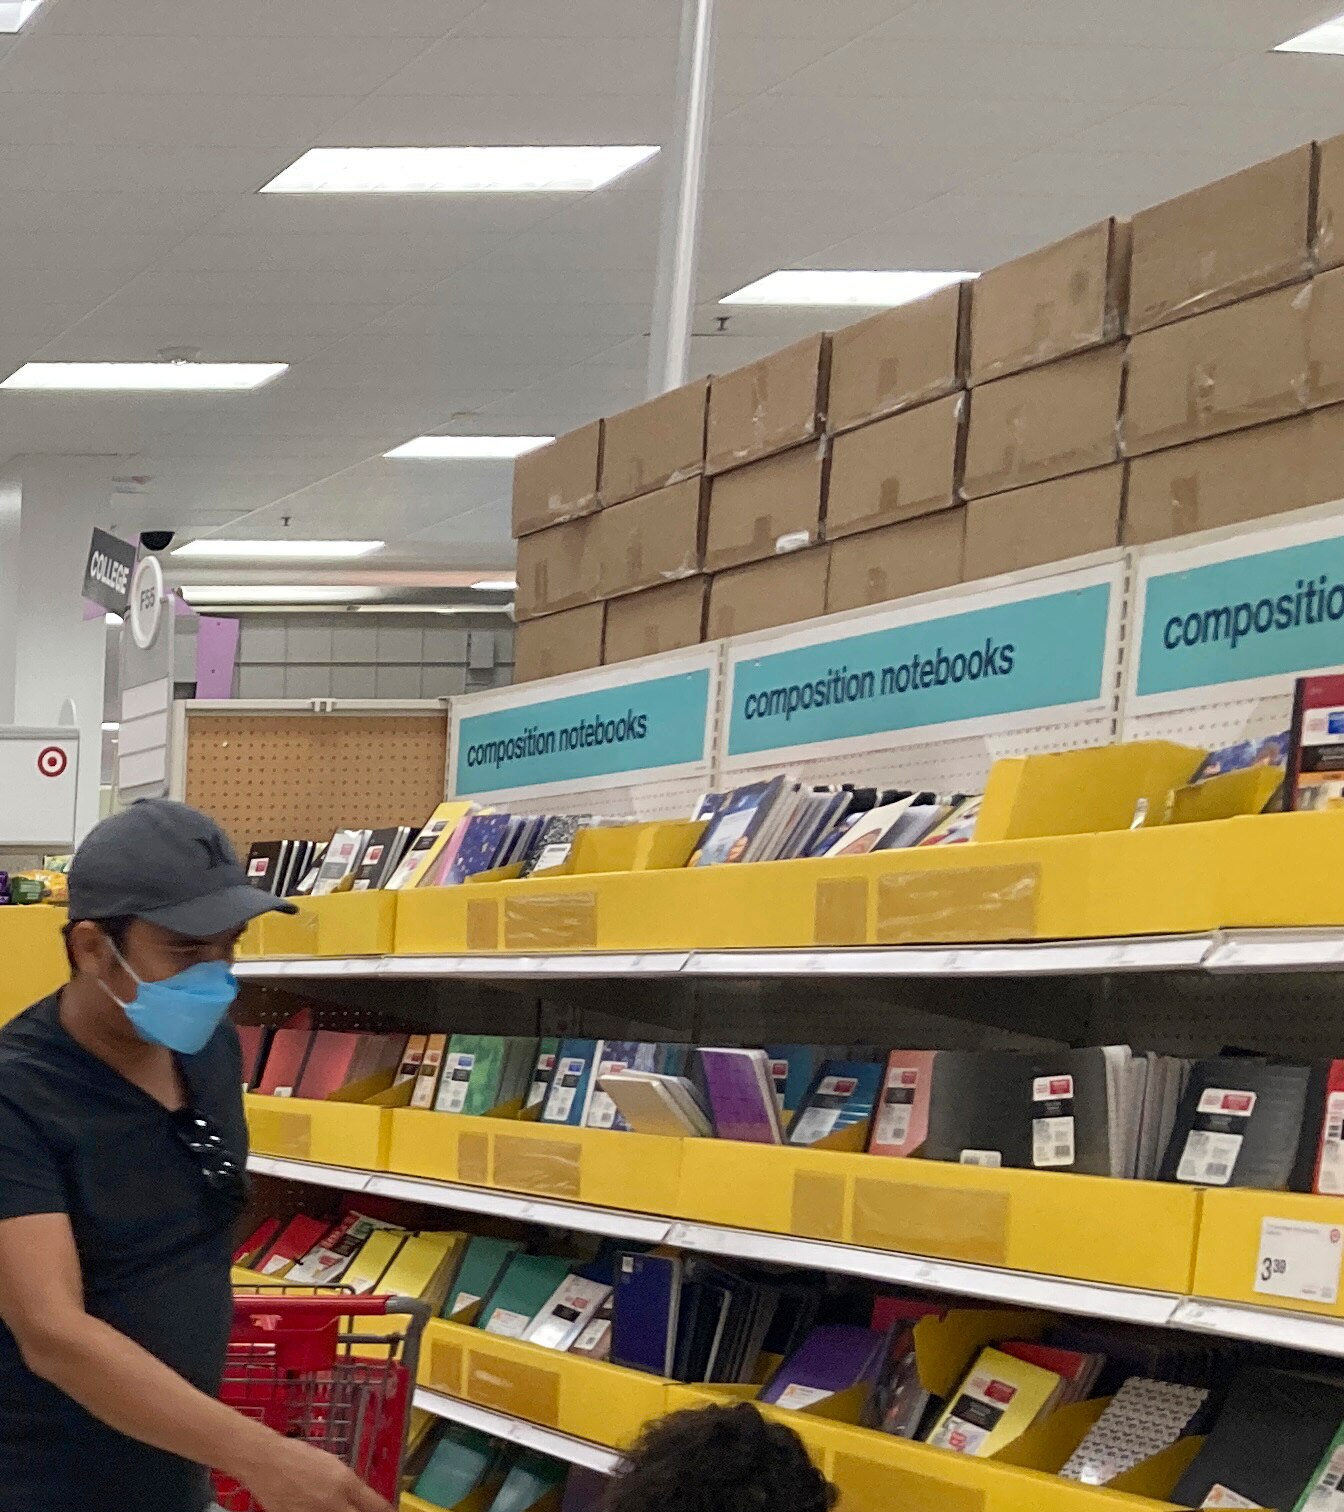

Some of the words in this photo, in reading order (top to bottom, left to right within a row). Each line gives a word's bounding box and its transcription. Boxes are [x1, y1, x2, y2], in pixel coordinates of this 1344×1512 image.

[90, 550, 130, 595] COLLEGE
[744, 669, 875, 722] composition
[879, 636, 1016, 698] notebooks
[467, 723, 556, 769] composition
[559, 708, 648, 752] notebooks
